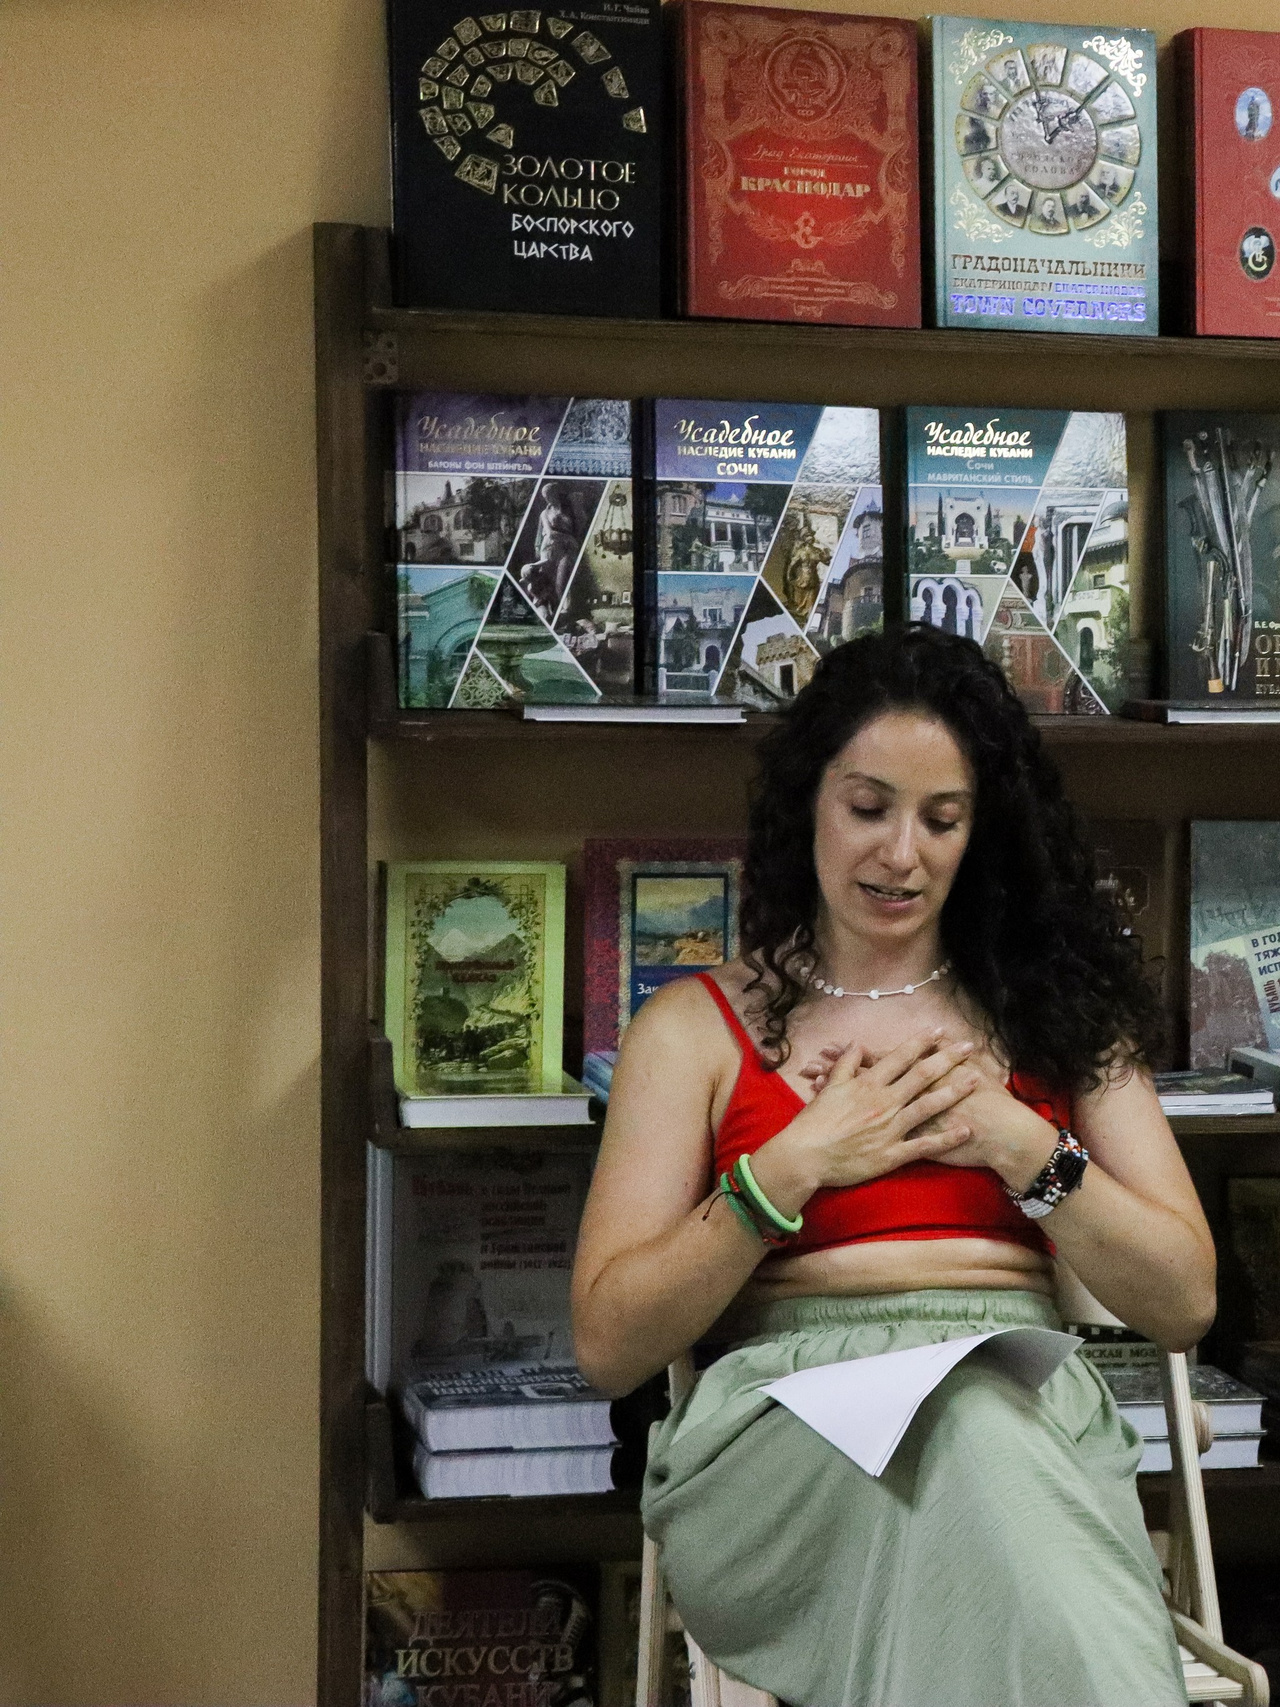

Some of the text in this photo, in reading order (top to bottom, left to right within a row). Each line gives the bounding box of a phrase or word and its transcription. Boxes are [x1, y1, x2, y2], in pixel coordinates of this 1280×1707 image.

[502, 154, 636, 184] ЗОЛОТОЕ
[502, 183, 620, 211] КОЛЬЦО
[740, 175, 871, 199] КРАСНОДАР
[511, 213, 635, 238] БОСПОРСКОГО
[513, 240, 593, 261] ЦАРСТВА
[951, 254, 1146, 280] ГРАДОНАЧАЛЬНИКИ
[950, 294, 1016, 316] TOWN
[417, 411, 541, 441] Усадебное
[673, 415, 795, 446] Усадебное
[924, 418, 1032, 446] Усадебное
[677, 446, 797, 460] НАСЛЕДИЕ КУБАНИ
[926, 446, 1034, 459] НАСЛЕДИЕ КУБАНИ
[464, 461, 485, 470] ФОН
[716, 462, 759, 476] СОЧИ
[966, 460, 995, 470] Сочи
[927, 472, 1034, 484] МАВРИТАНСКИЙ СТИЛЬ
[1255, 657, 1271, 678] И
[1251, 938, 1260, 948] В
[408, 1609, 564, 1648] ДЕЯТЕЛИ
[394, 1644, 575, 1678] ИСКУССТВ
[415, 1681, 557, 1707] КУБАНИ
